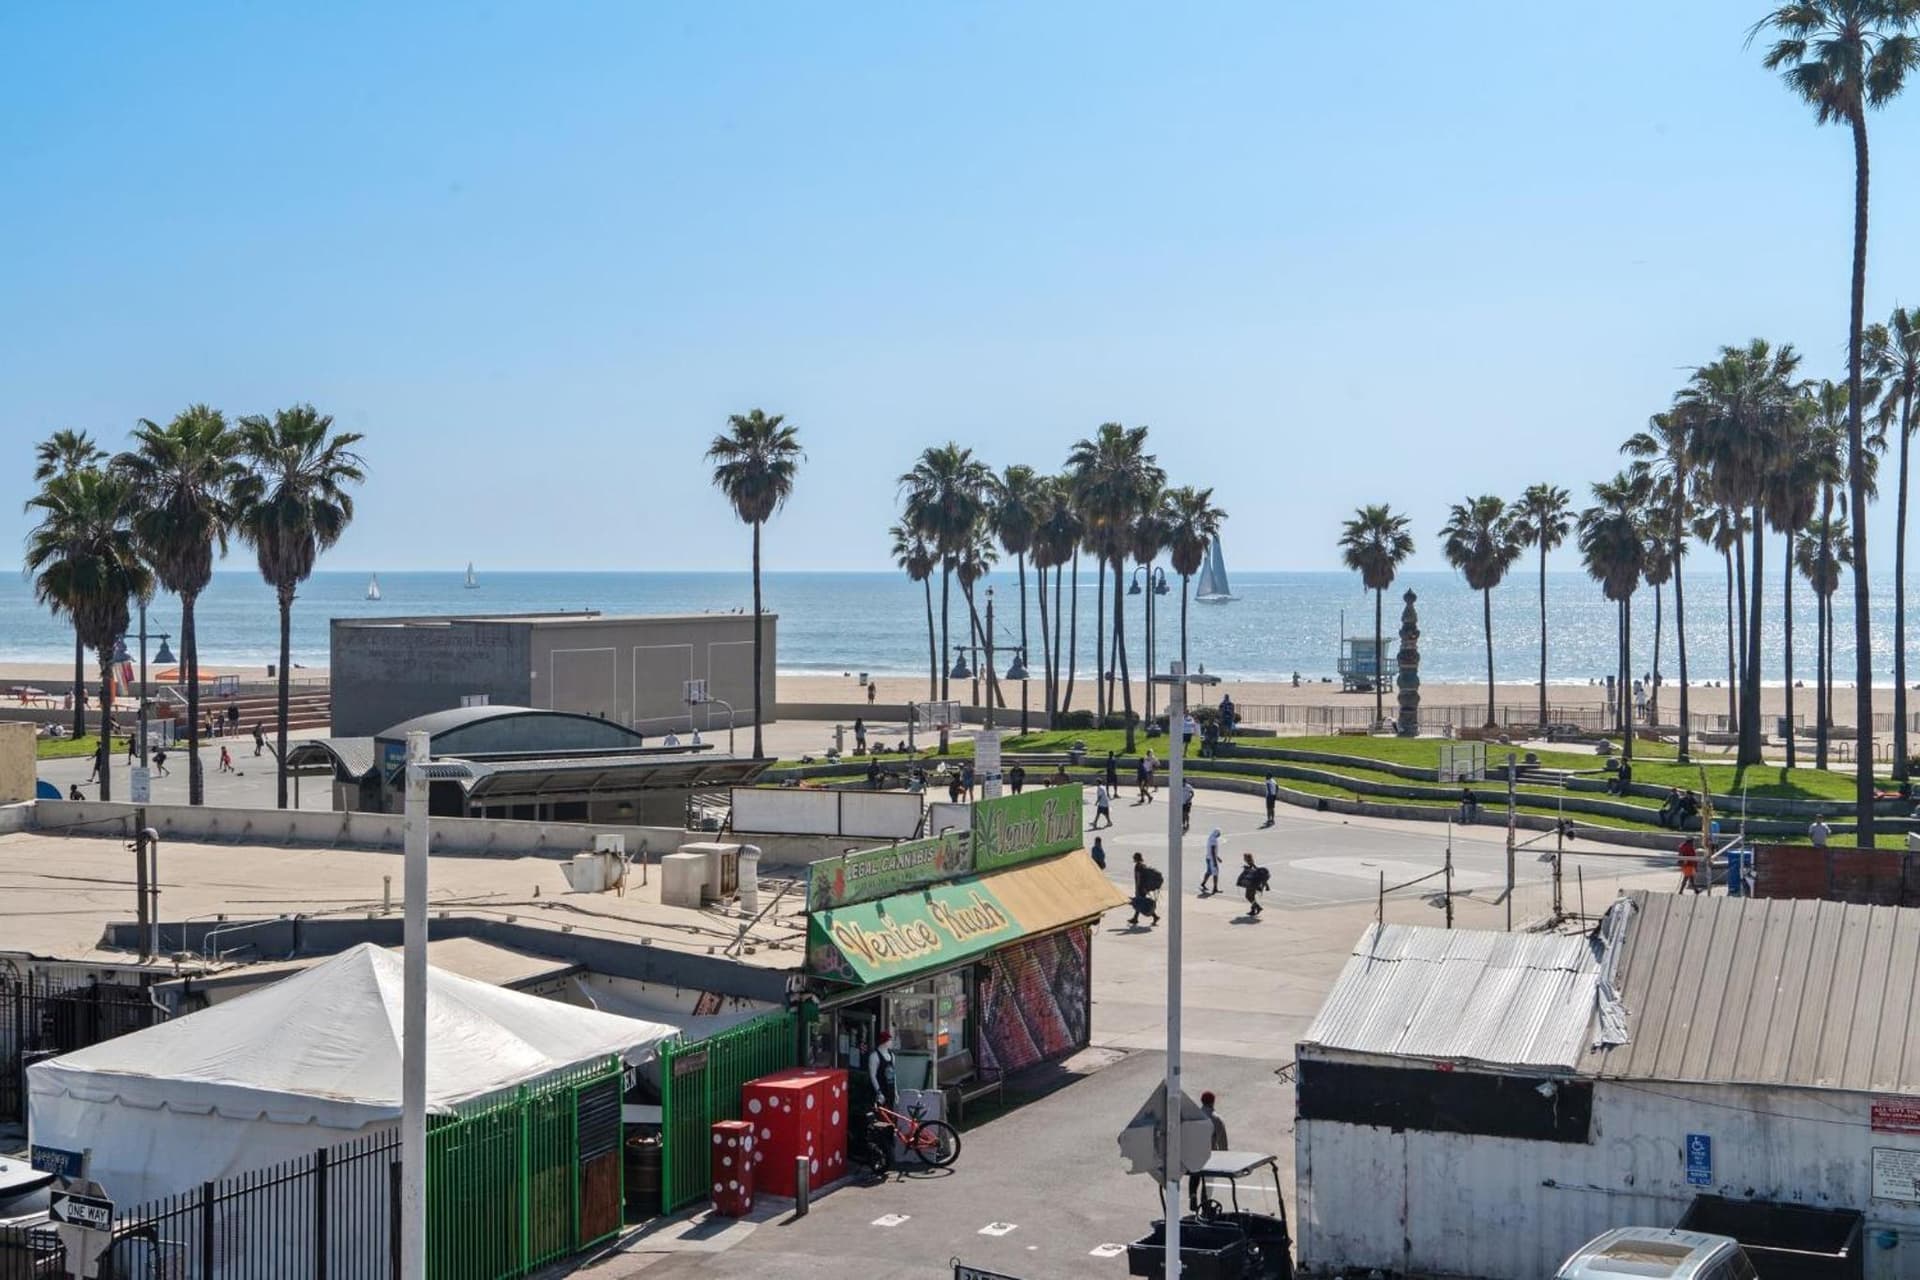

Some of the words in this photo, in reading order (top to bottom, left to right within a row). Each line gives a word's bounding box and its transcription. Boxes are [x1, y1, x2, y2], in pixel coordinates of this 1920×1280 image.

[993, 808, 1040, 856] Venice
[1042, 798, 1077, 844] Kush
[847, 861, 878, 880] LEGAL
[881, 847, 935, 872] CANNABIS
[833, 912, 942, 966] Venice
[930, 888, 1008, 942] Kush
[68, 1203, 85, 1218] ONE
[88, 1206, 107, 1222] WAY
